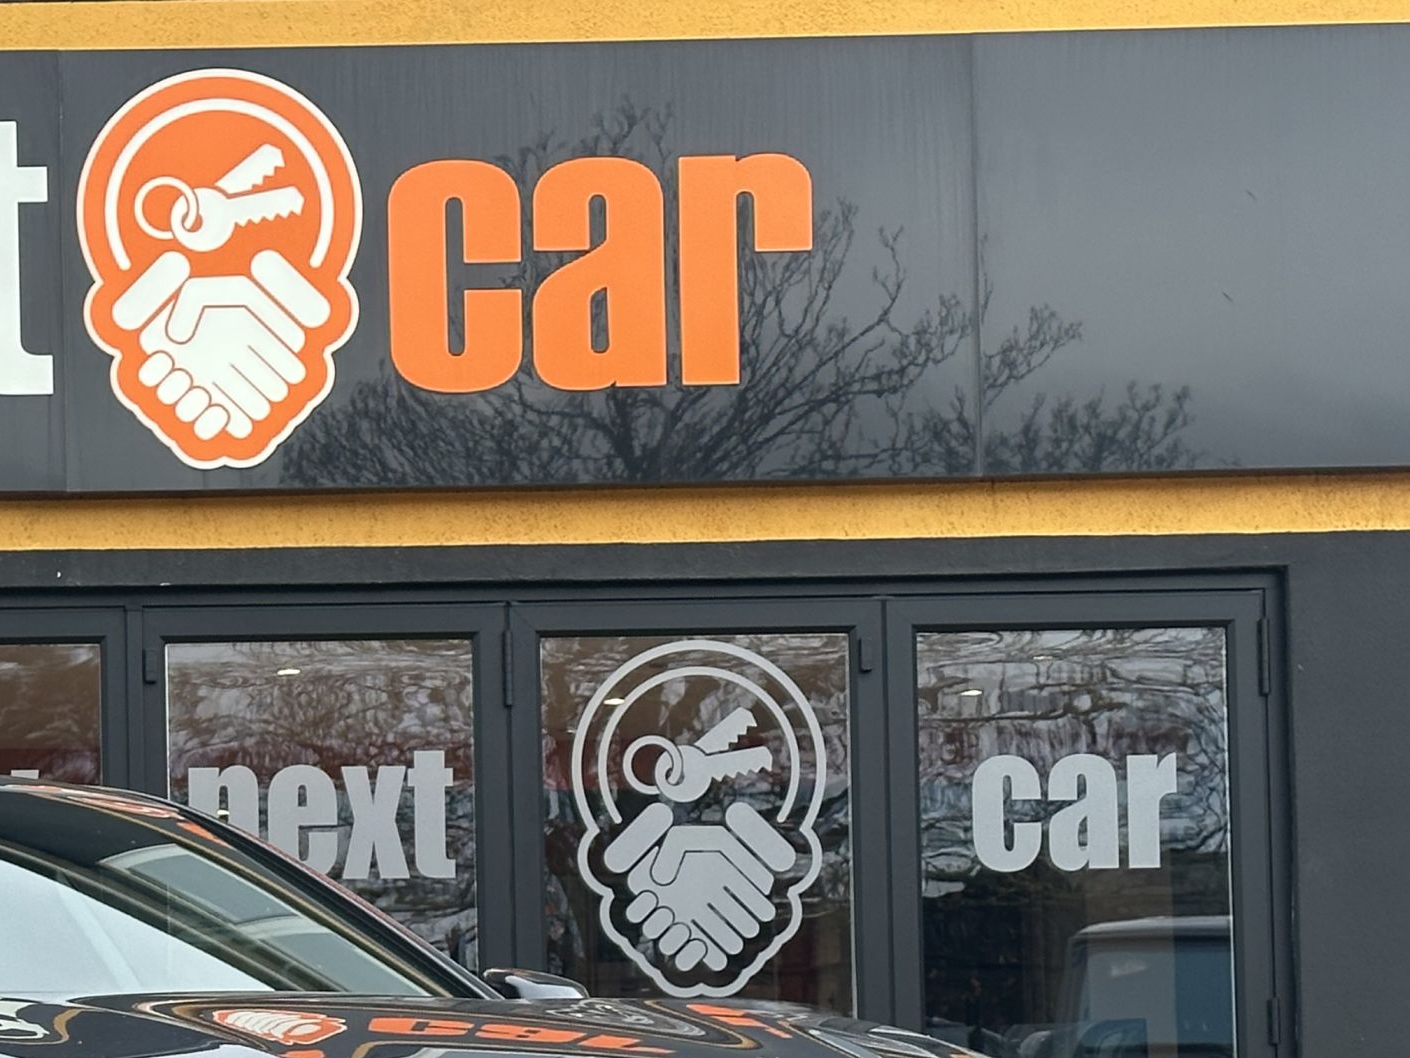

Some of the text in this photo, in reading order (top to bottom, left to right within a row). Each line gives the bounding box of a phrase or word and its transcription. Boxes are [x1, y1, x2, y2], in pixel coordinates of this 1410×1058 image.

[389, 152, 816, 392] car
[188, 749, 1178, 880] next car
